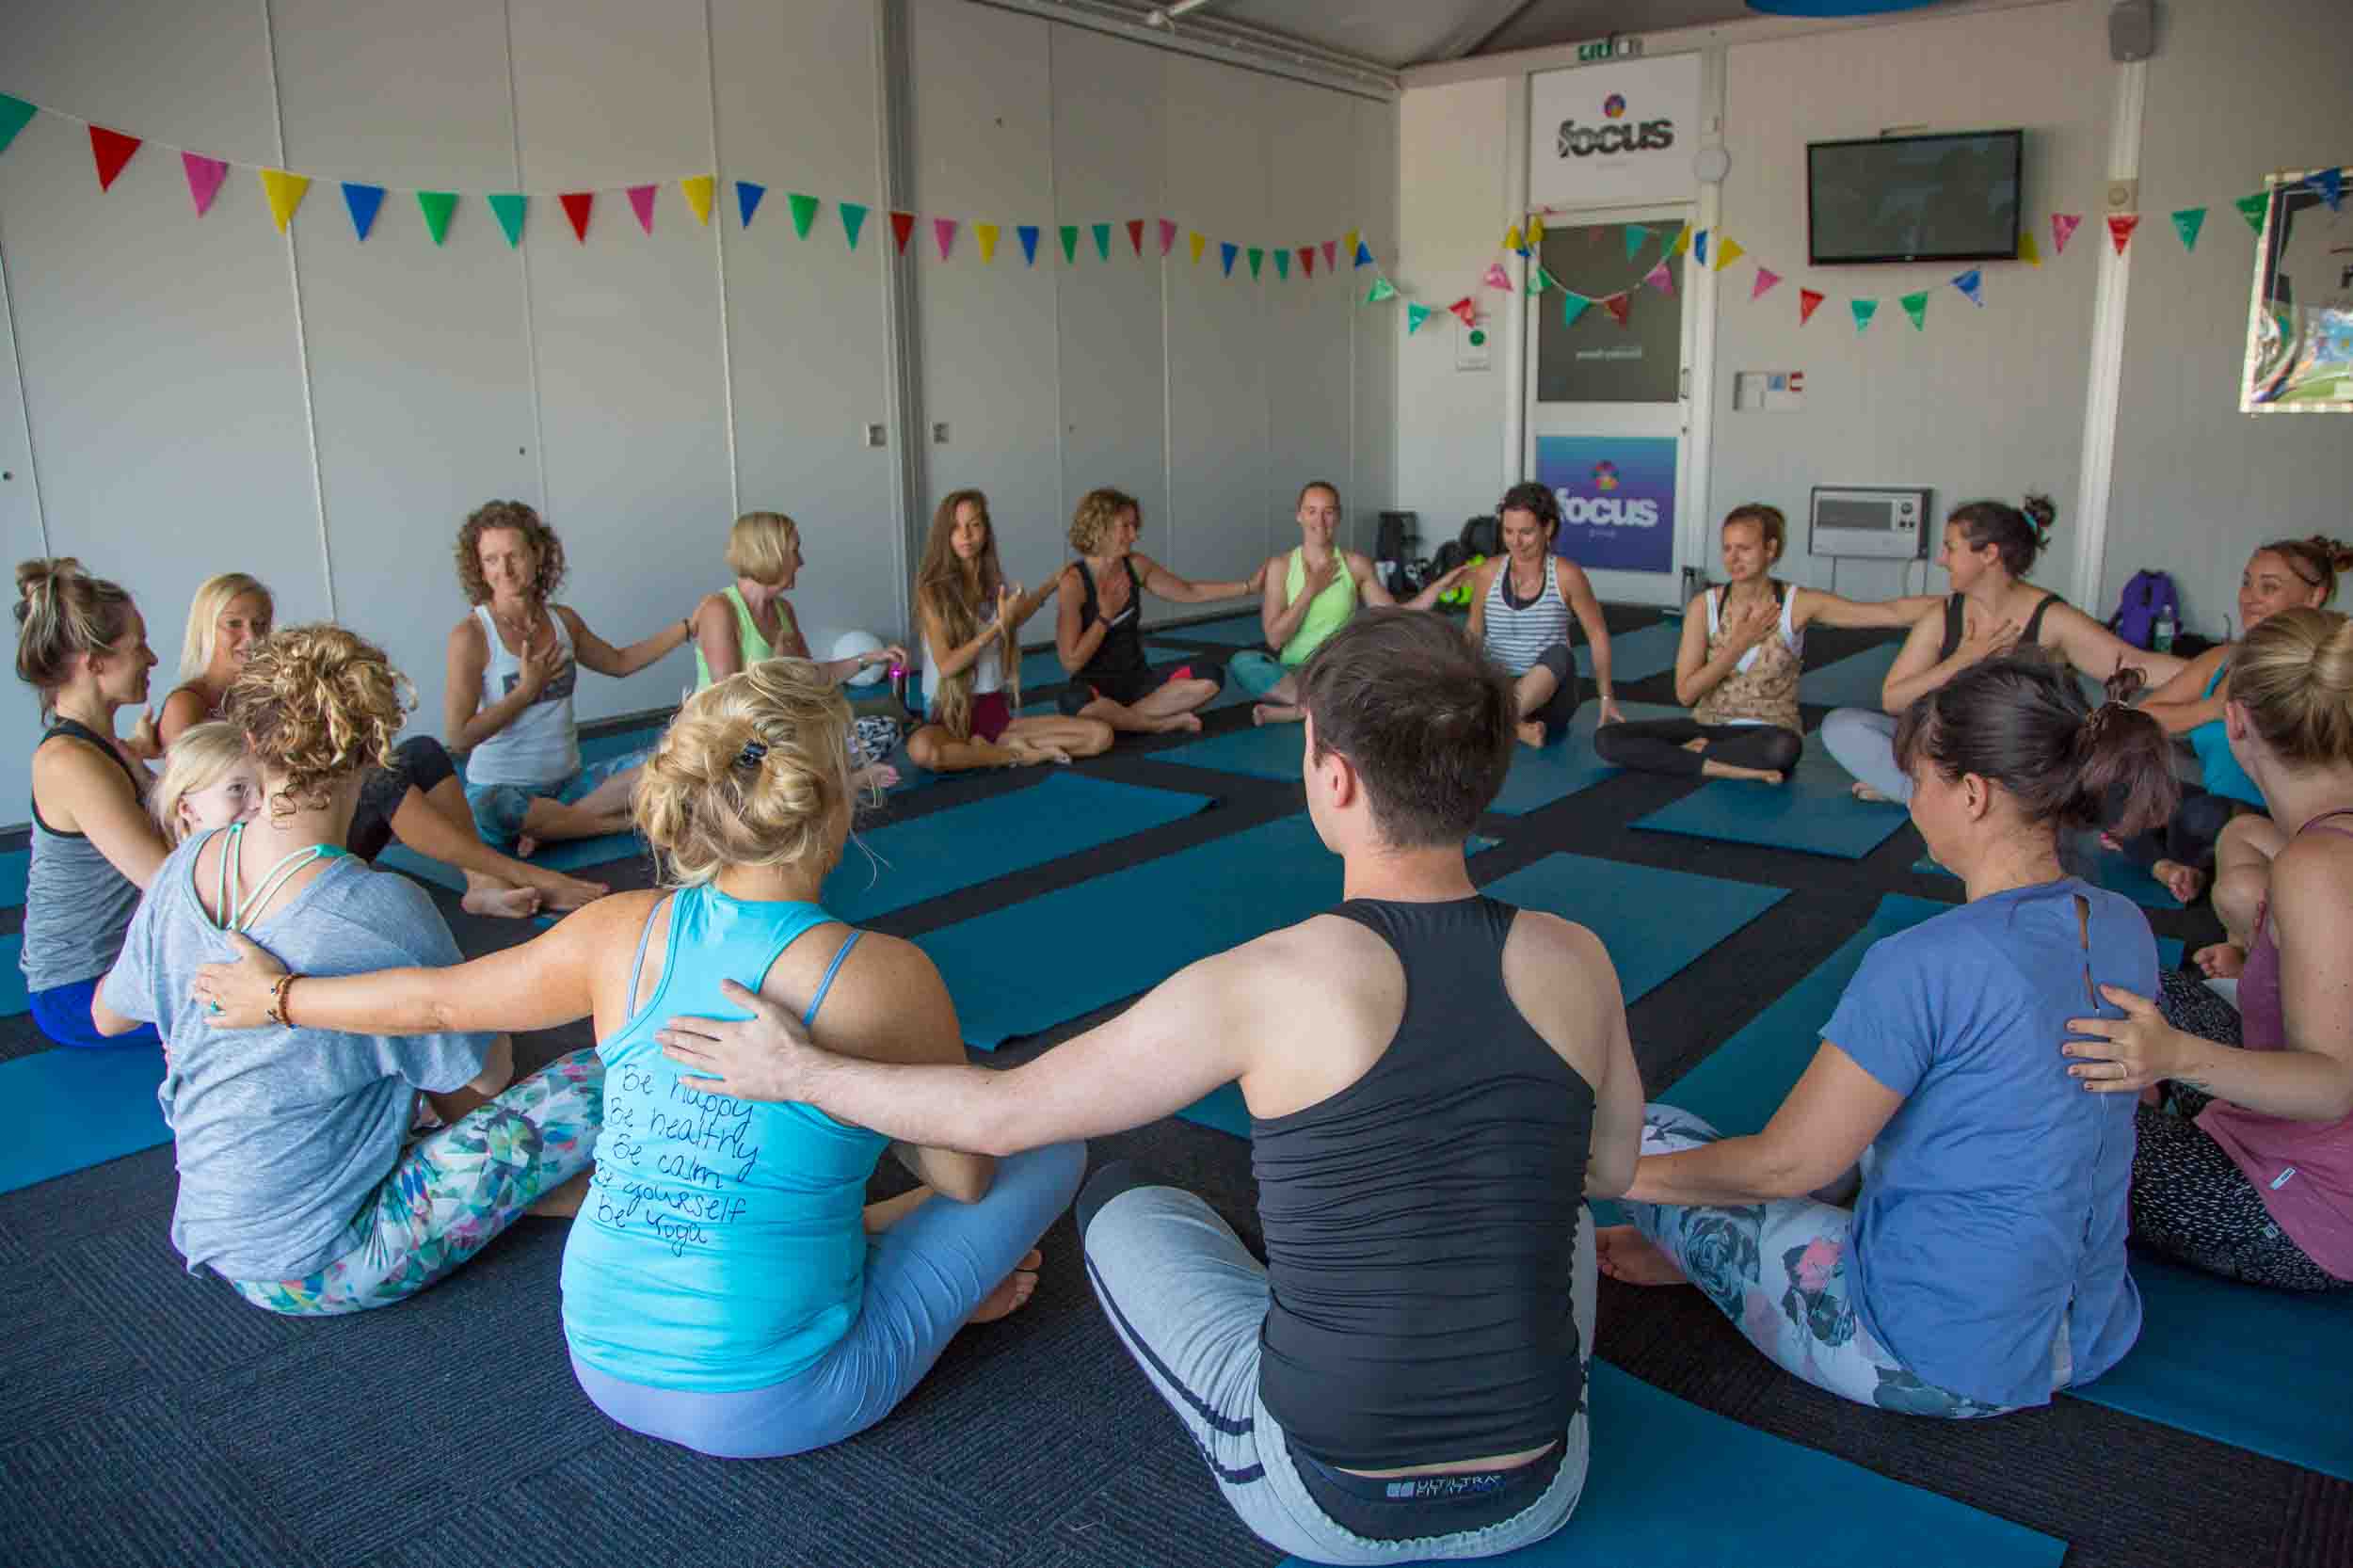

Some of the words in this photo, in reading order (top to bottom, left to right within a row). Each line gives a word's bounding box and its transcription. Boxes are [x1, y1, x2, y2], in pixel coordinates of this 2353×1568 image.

[1558, 120, 1674, 159] focus
[1553, 488, 1659, 528] focus
[669, 1068, 753, 1144] happy
[650, 1107, 760, 1183] healthy
[657, 1153, 724, 1190] calm
